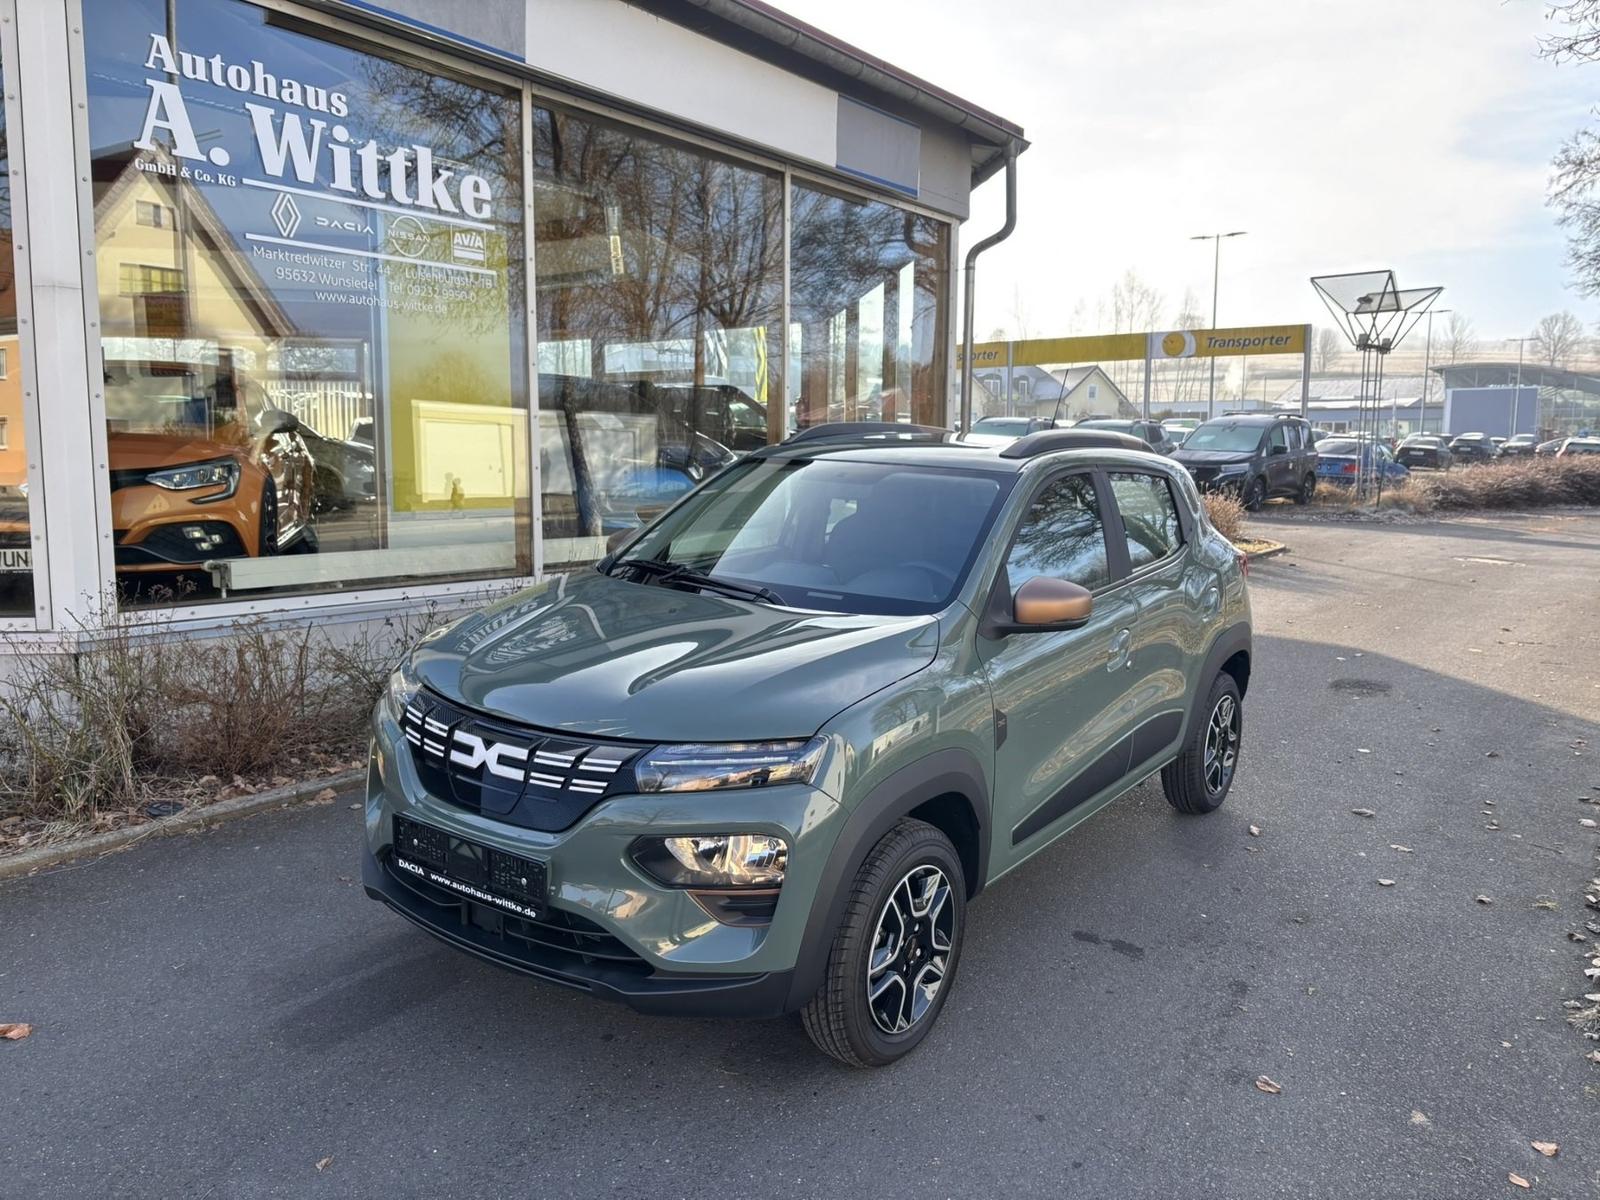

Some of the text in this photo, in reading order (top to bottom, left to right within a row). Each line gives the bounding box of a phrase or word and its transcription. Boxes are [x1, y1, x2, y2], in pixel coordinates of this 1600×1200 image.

[144, 33, 349, 118] Autohaus
[133, 78, 494, 219] A. Wittke
[134, 157, 236, 187] GmbH & Co. KG
[315, 216, 375, 235] DACIA
[387, 229, 430, 244] NISSAN
[253, 245, 345, 270] Marktredwitzer
[352, 259, 372, 273] Str.
[376, 264, 391, 275] 44
[276, 266, 316, 283] 95632
[318, 273, 377, 290] Wunsiedel
[1207, 335, 1292, 350] Transporter
[0, 551, 28, 567] UN
[398, 859, 537, 918] DACIA www.autohaus-wittke.de
